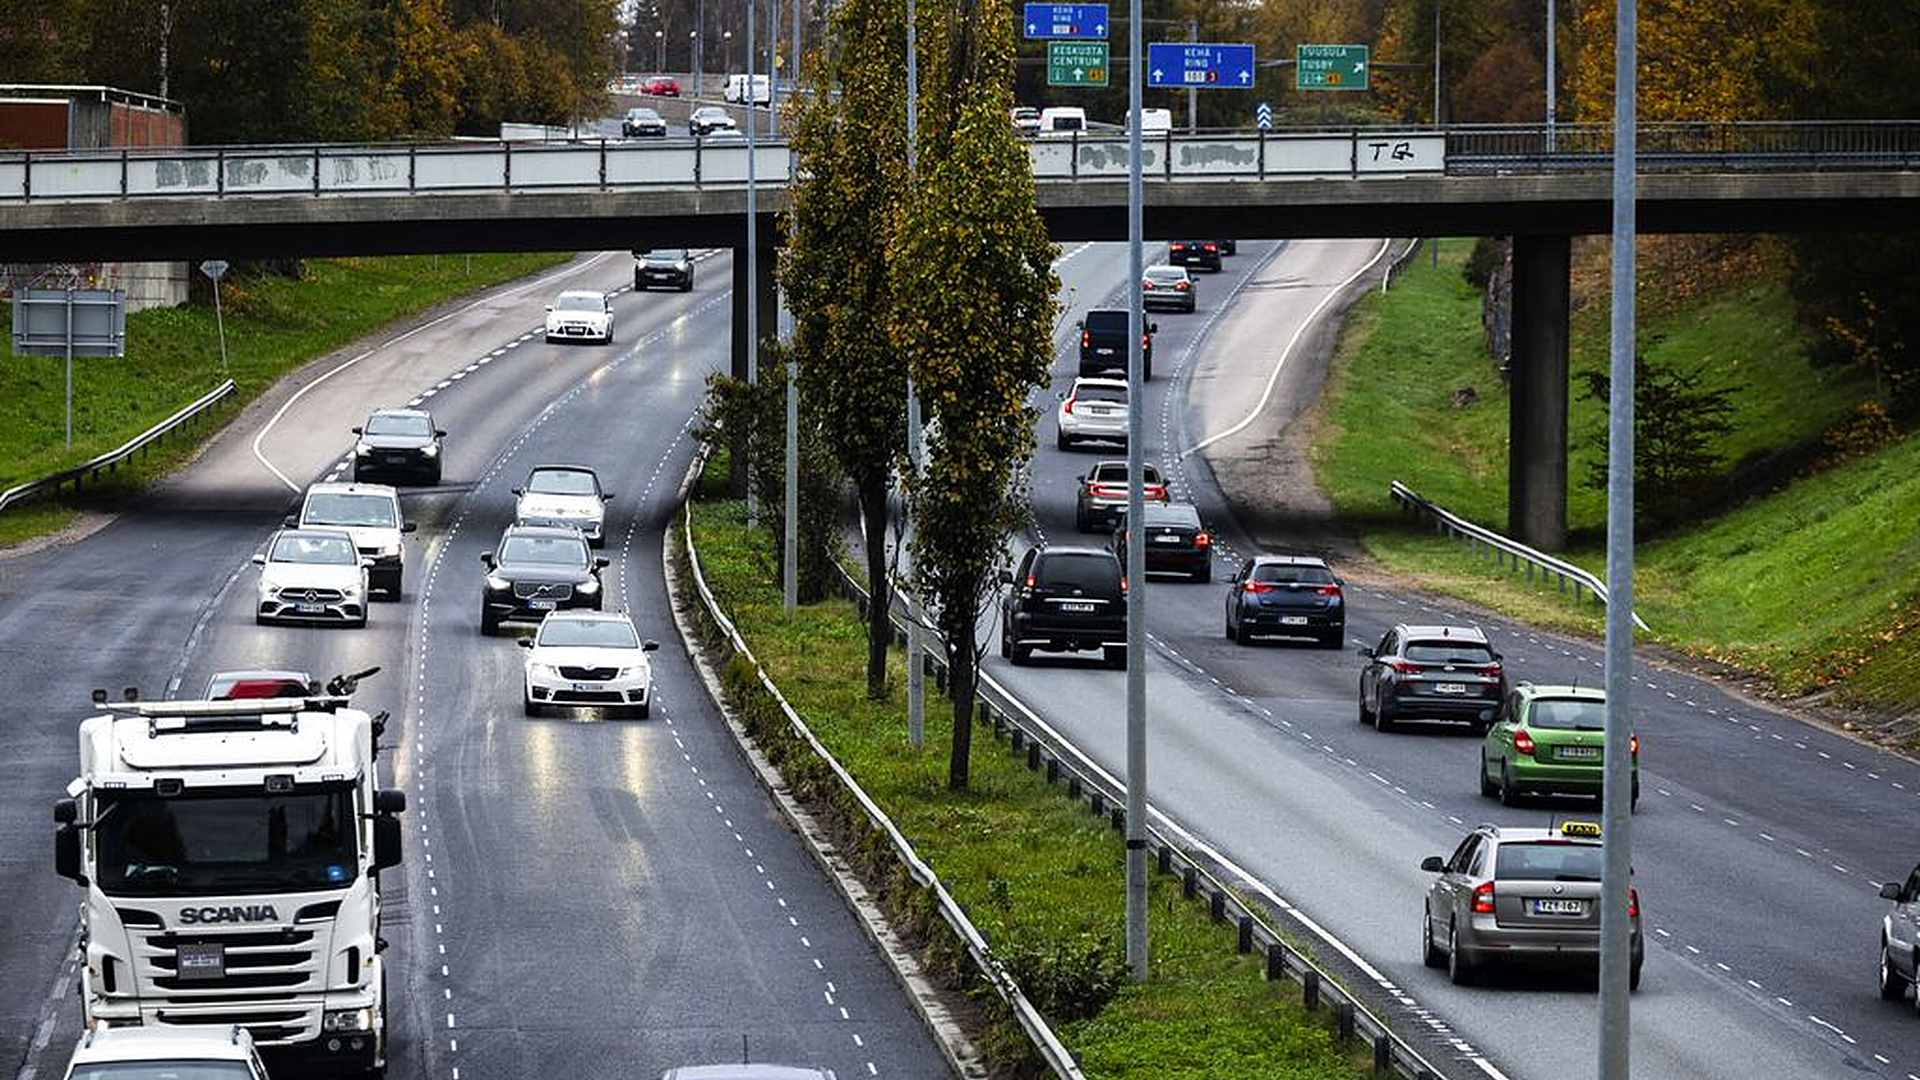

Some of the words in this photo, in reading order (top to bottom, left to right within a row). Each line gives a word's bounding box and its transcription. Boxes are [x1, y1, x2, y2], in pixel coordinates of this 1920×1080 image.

[1052, 46, 1103, 55] KESKUSTA
[1302, 46, 1347, 57] TUUSULA
[1053, 57, 1101, 66] CENTRUM
[1566, 824, 1598, 833] TAXI
[180, 904, 279, 924] SCANIA
